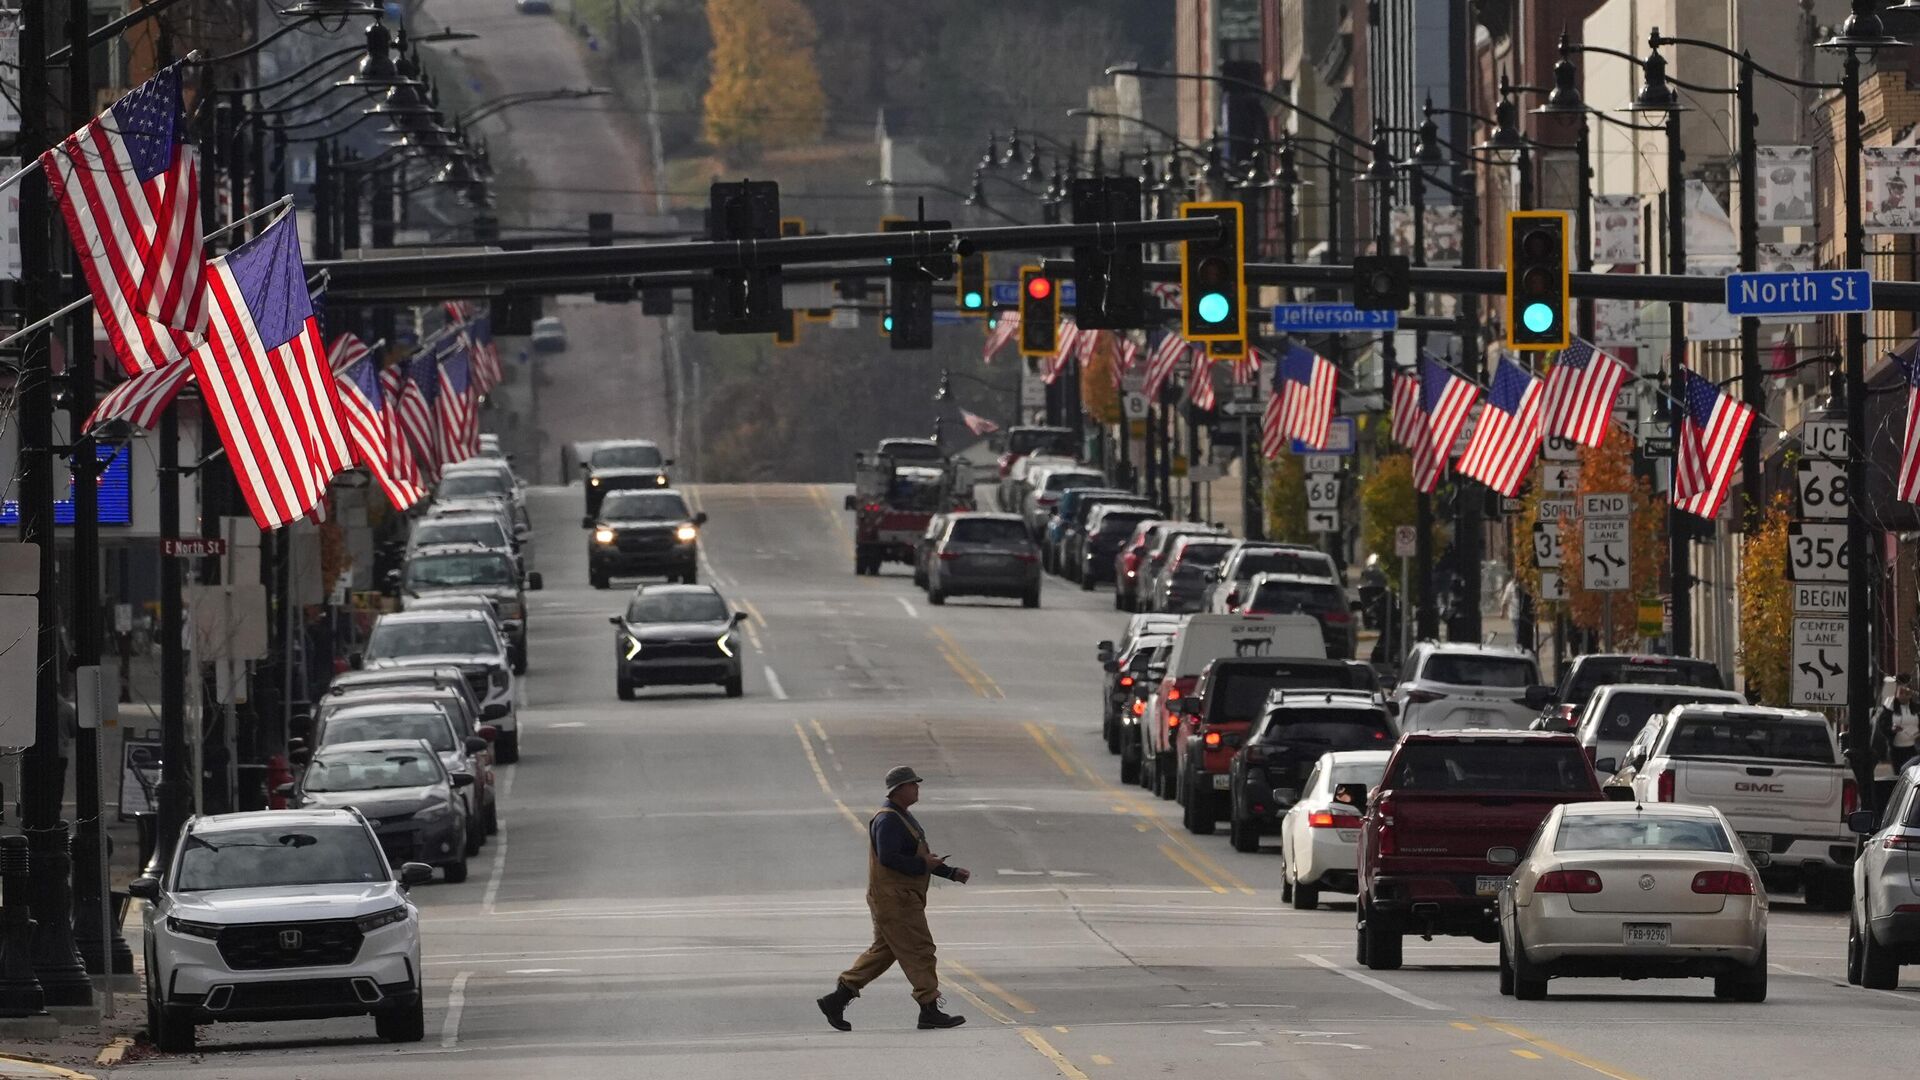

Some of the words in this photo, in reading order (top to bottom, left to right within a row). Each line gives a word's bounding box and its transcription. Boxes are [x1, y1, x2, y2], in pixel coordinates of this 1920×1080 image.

[1741, 276, 1817, 303] North
[1831, 276, 1858, 301] St
[1281, 307, 1364, 325] Jefferson
[1372, 309, 1389, 323] St
[1805, 427, 1848, 452] JCT
[1310, 482, 1335, 501] 68
[1803, 475, 1849, 507] 68
[1587, 498, 1624, 512] END
[1588, 522, 1624, 531] CENTER
[1593, 531, 1618, 540] LANE
[165, 541, 172, 554] E
[175, 541, 205, 554] North
[207, 541, 220, 554] St
[1794, 536, 1849, 570] 356
[1594, 578, 1619, 588] ONLY
[1800, 589, 1847, 607] BEGIN
[1800, 621, 1845, 632] CENTER
[1806, 633, 1837, 643] LANE
[1804, 691, 1836, 701] ONLY
[1734, 782, 1784, 793] GMC
